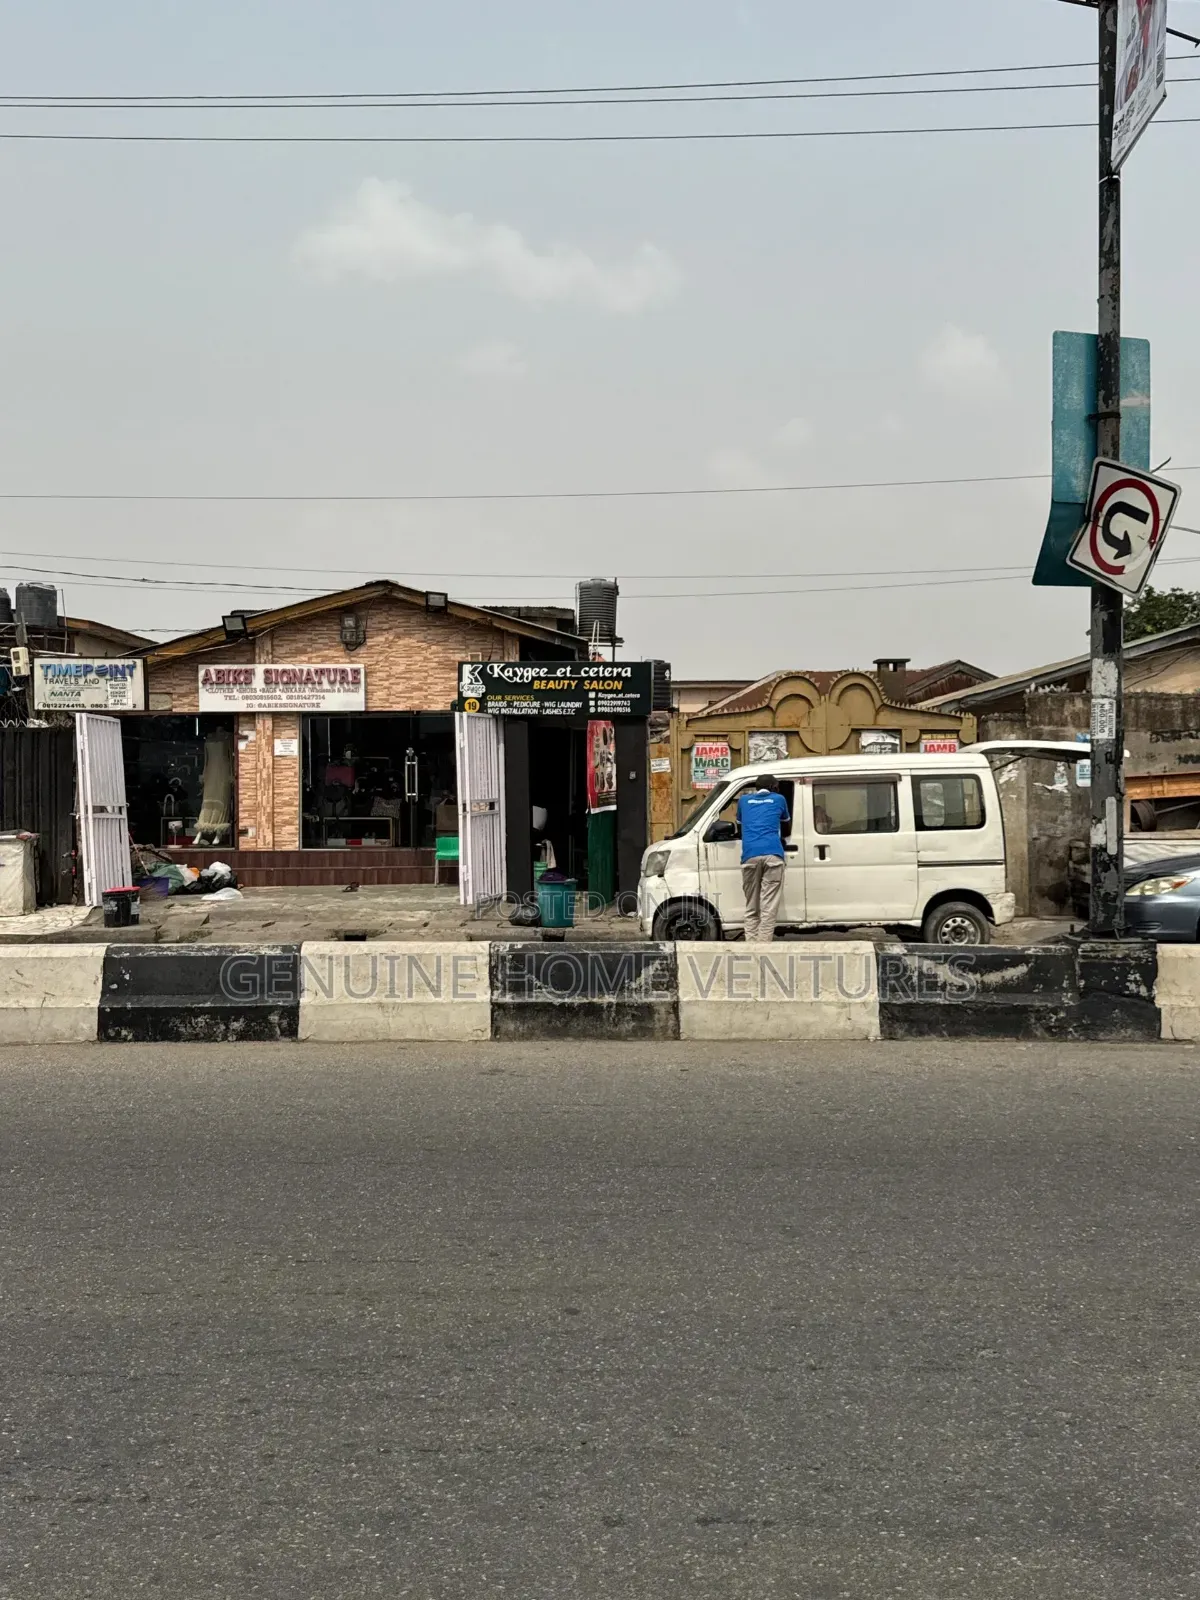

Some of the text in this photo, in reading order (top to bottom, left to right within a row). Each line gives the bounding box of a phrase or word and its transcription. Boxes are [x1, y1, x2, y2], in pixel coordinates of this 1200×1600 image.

[40, 663, 137, 678] TIMEPOINT
[263, 667, 361, 685] SIGNATURE
[486, 663, 632, 684] Kaygee_et_cetera
[44, 677, 79, 685] TRAVELS
[83, 677, 100, 685] AND
[532, 679, 624, 690] BEAUTY SALON
[467, 701, 477, 711] 19
[694, 757, 729, 768] WAEC
